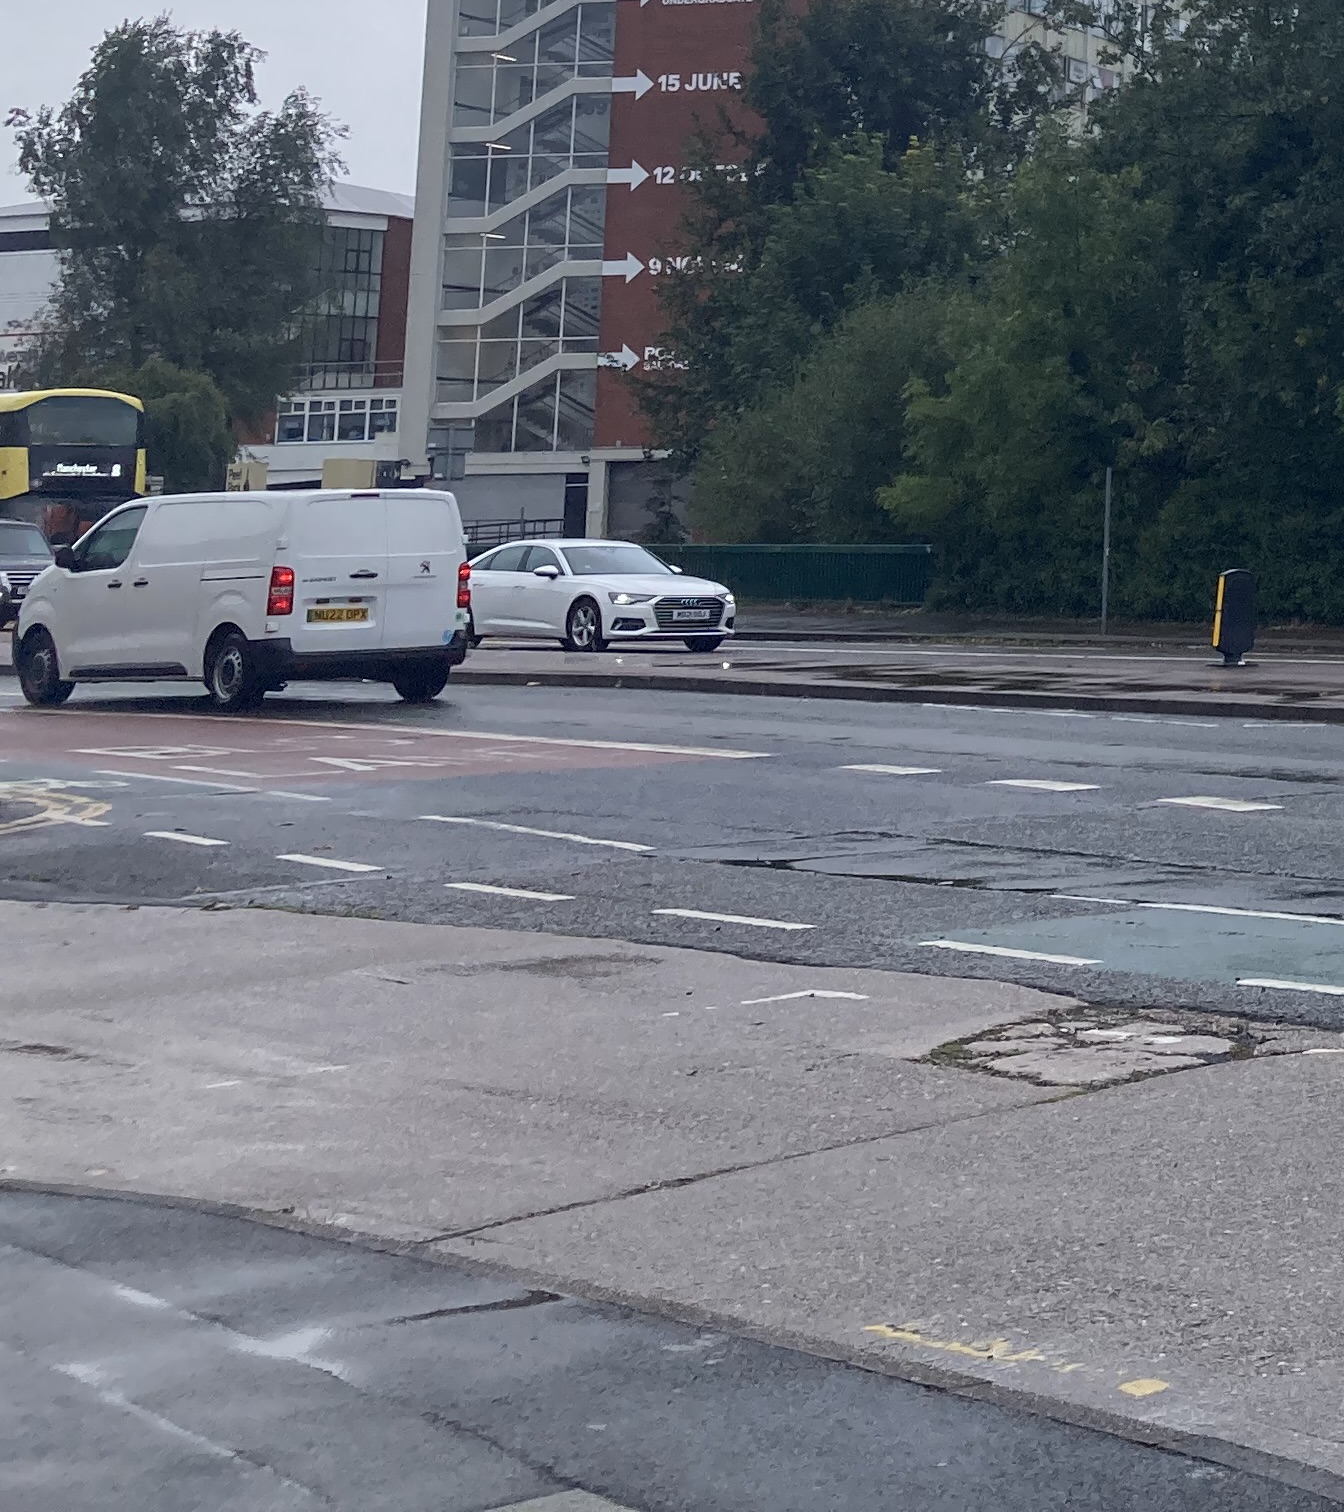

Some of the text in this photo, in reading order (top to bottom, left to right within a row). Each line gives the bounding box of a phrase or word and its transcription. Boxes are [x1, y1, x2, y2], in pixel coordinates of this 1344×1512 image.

[657, 71, 742, 93] 15 JUNE
[652, 166, 675, 185] 12
[648, 256, 662, 276] 9
